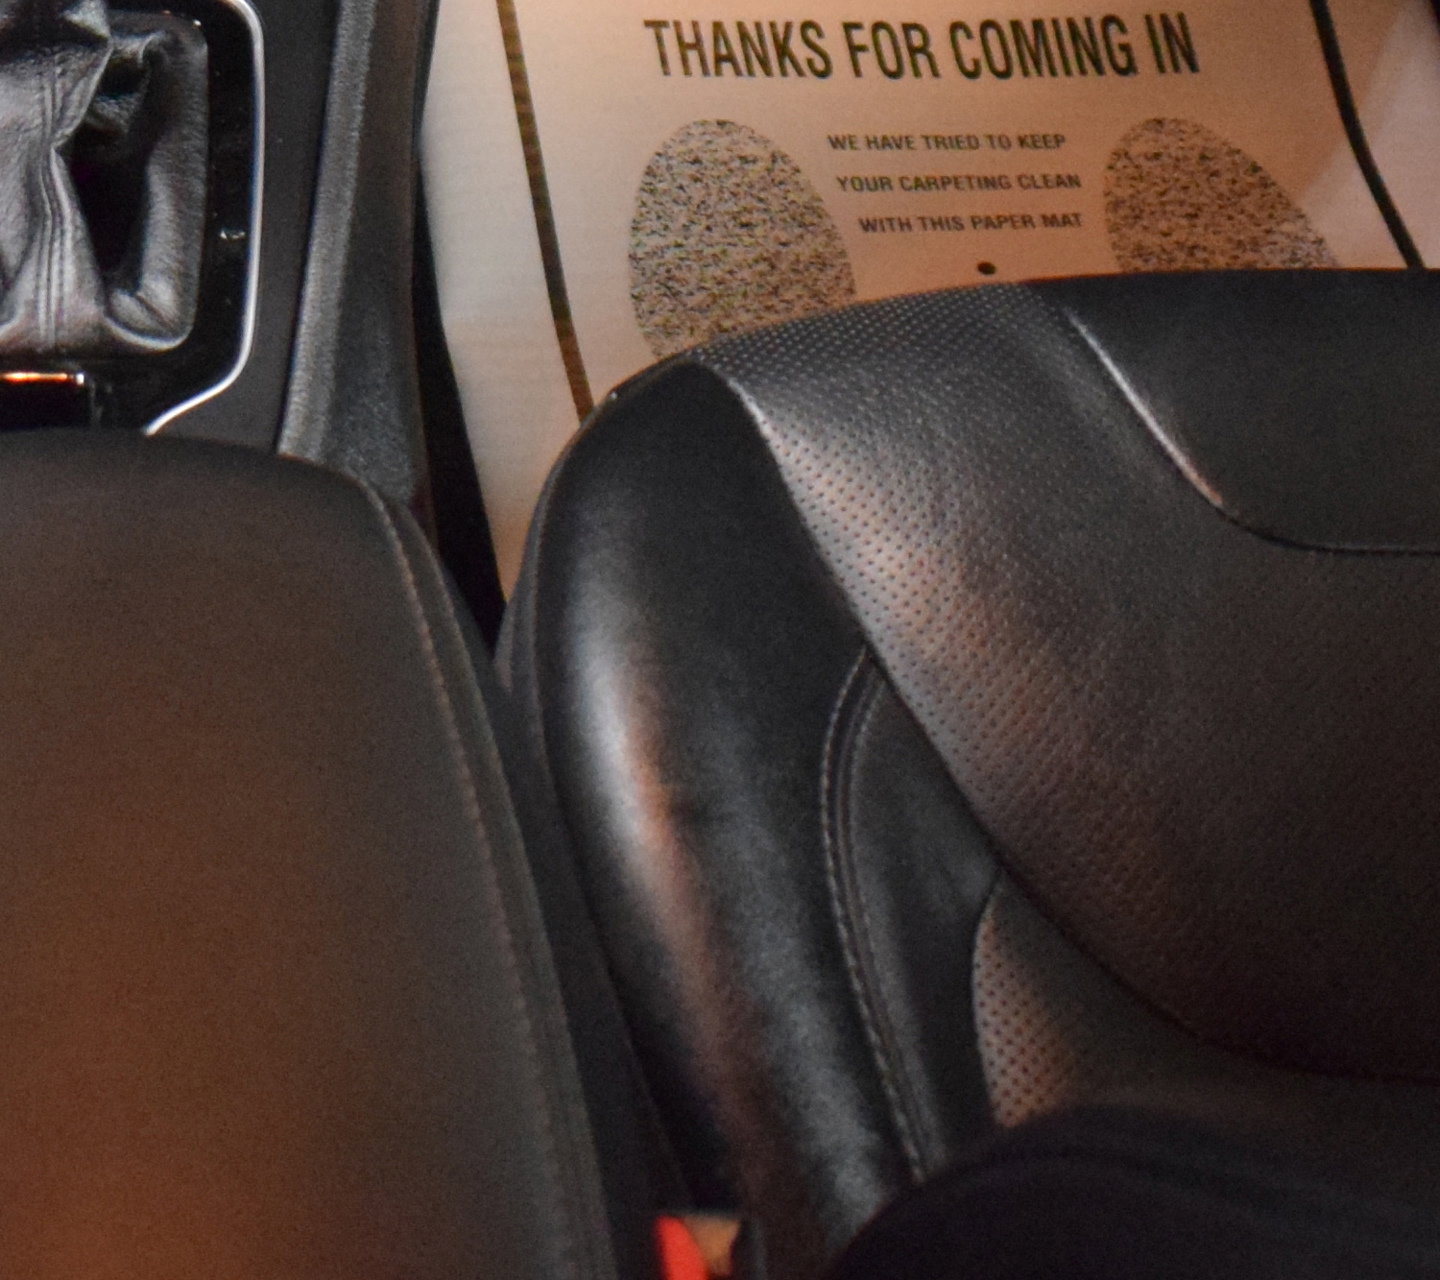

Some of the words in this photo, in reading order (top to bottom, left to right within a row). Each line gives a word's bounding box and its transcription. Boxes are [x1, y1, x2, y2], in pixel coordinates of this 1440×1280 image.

[643, 18, 834, 80] THANKS
[841, 19, 941, 80] FOR
[948, 14, 1139, 80] COMING
[1143, 11, 1200, 75] IN
[827, 135, 858, 150] WE
[864, 135, 917, 150] HAVE
[921, 134, 980, 150] TRIED
[986, 134, 1012, 150] TO
[1017, 134, 1066, 149] KEEP
[836, 176, 893, 191] YOUR
[899, 174, 1012, 191] CARPETING
[1017, 174, 1082, 189] CLEAN
[858, 216, 913, 232] WITH
[919, 216, 965, 232] THIS
[971, 213, 1037, 230] PAPER
[1042, 212, 1083, 228] MAT
